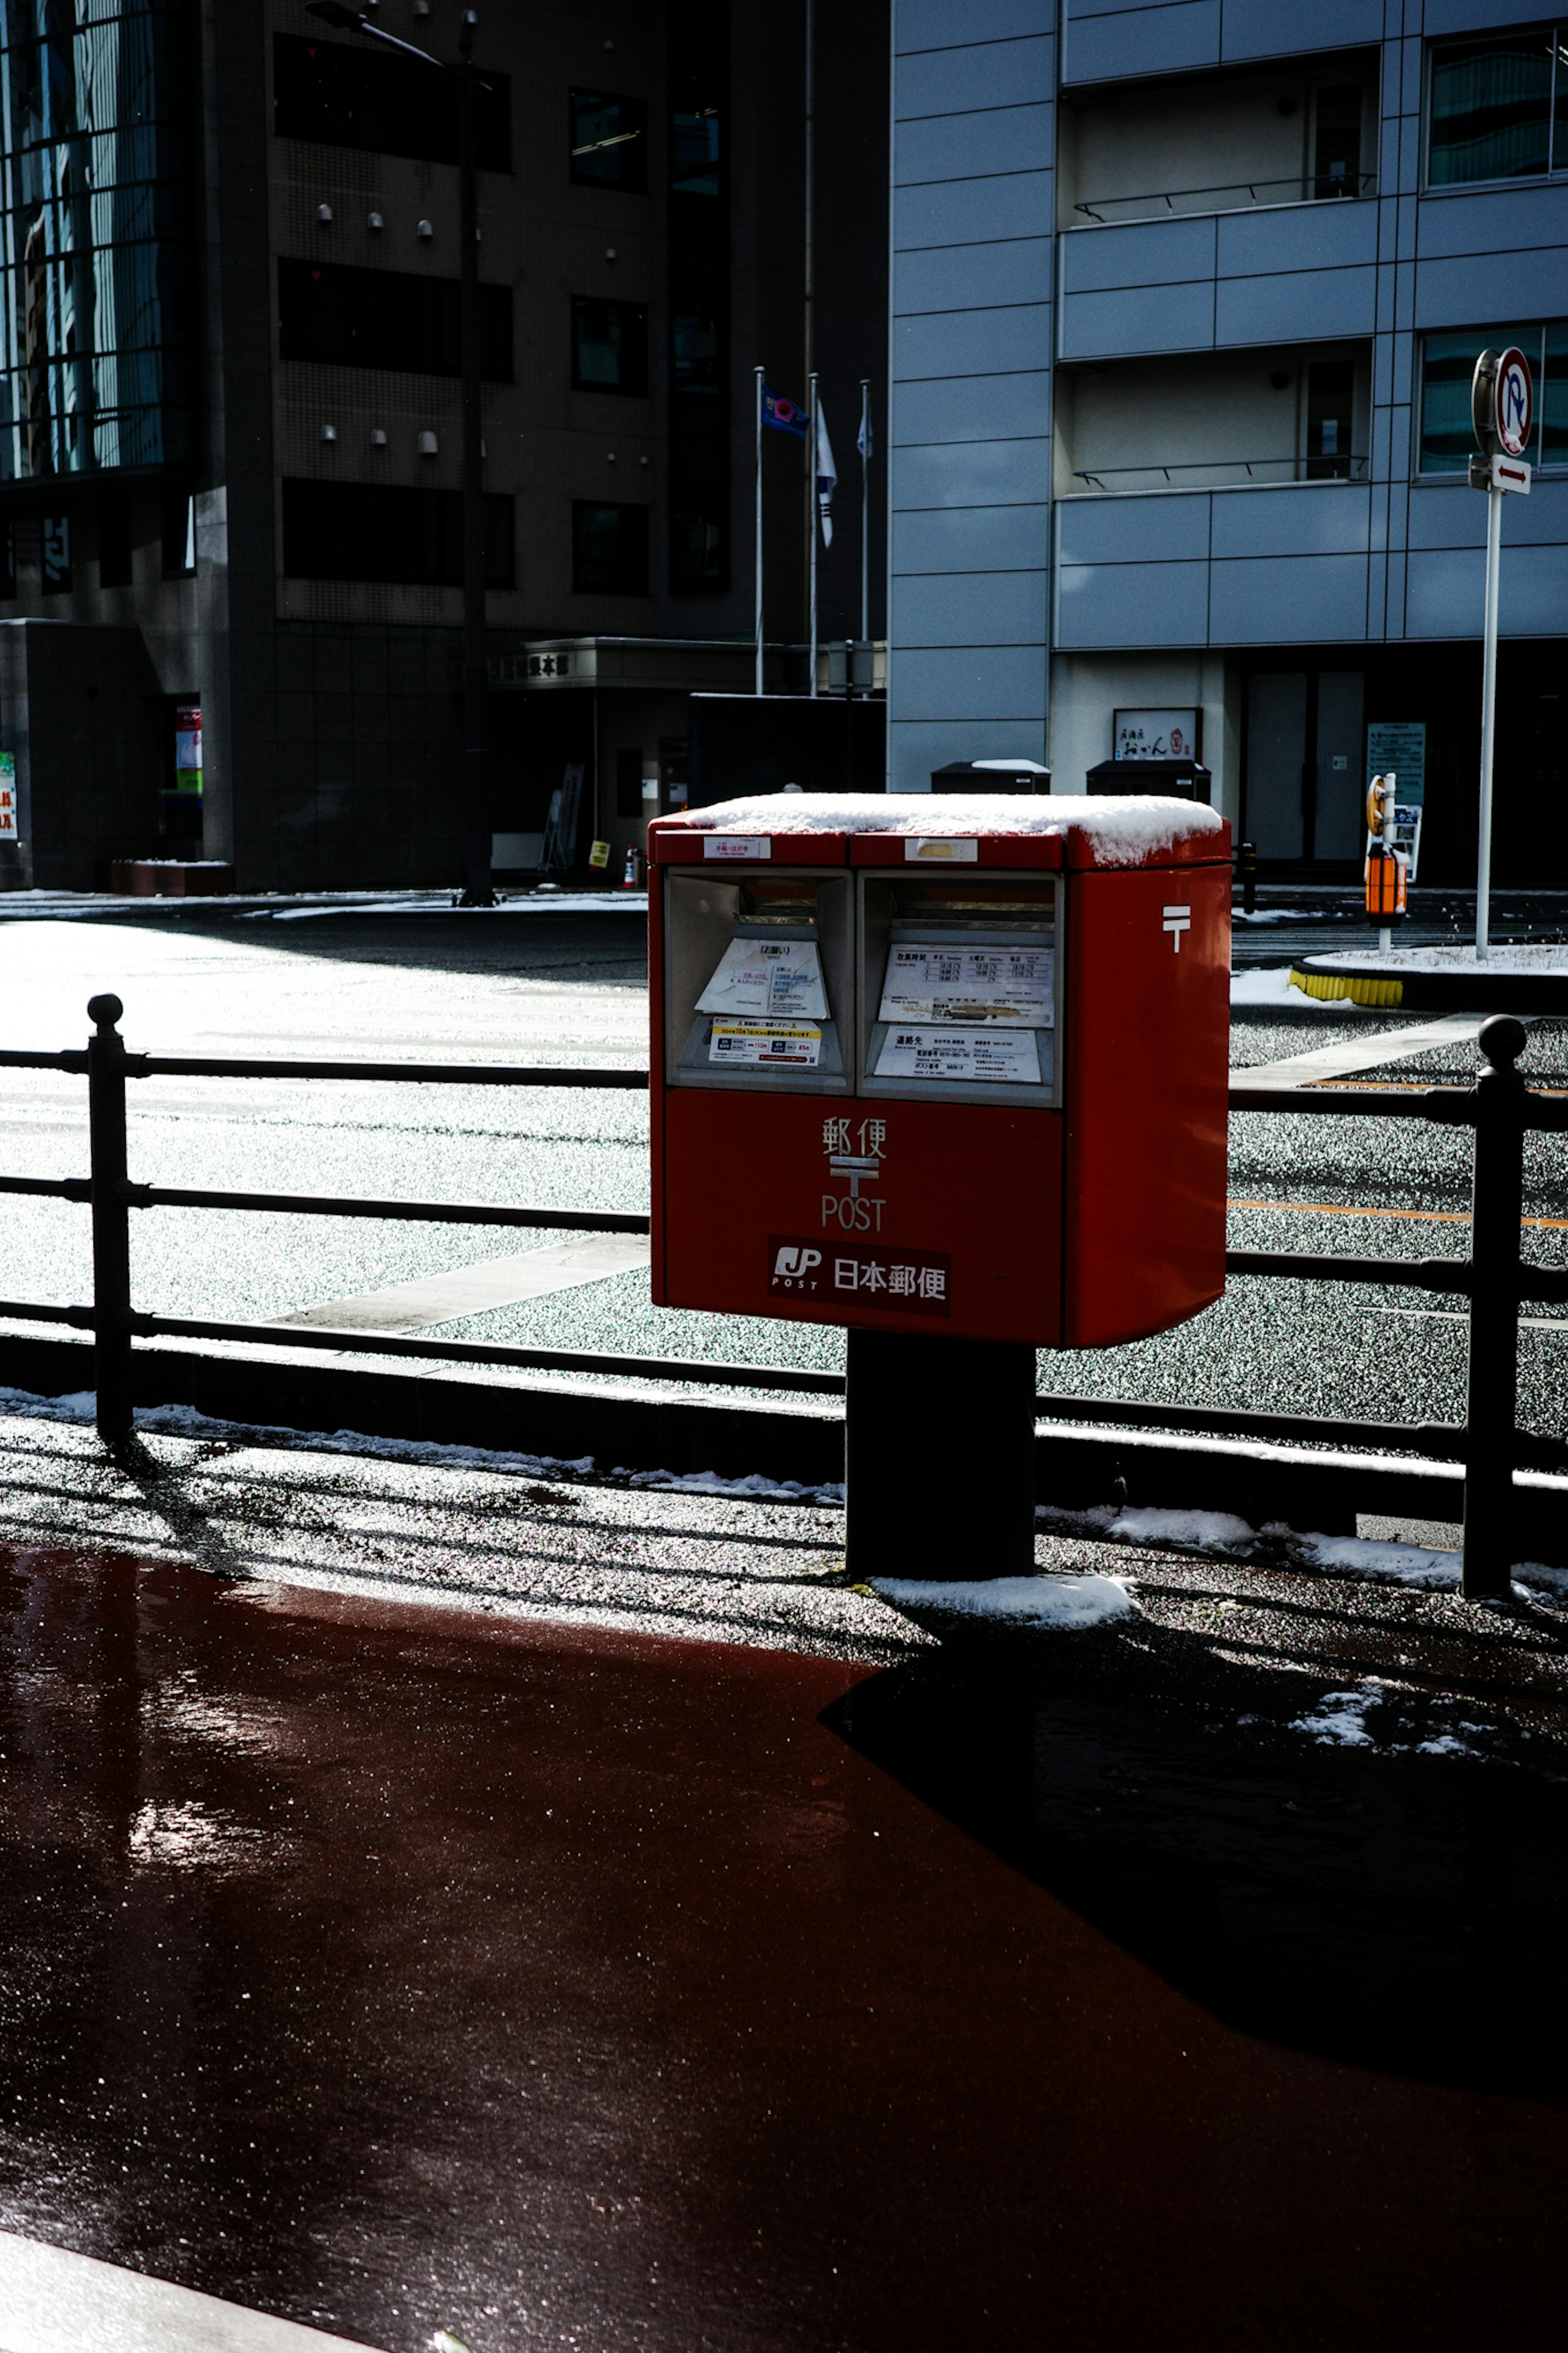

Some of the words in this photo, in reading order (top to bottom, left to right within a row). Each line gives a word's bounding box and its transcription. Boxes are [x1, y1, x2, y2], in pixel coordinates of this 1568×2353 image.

[1124, 736, 1167, 756] おかん
[822, 1116, 886, 1158] 郵便
[822, 1195, 886, 1232] POST
[774, 1247, 822, 1278] JP
[833, 1258, 945, 1300] 日本郵便
[771, 1277, 817, 1290] POST
